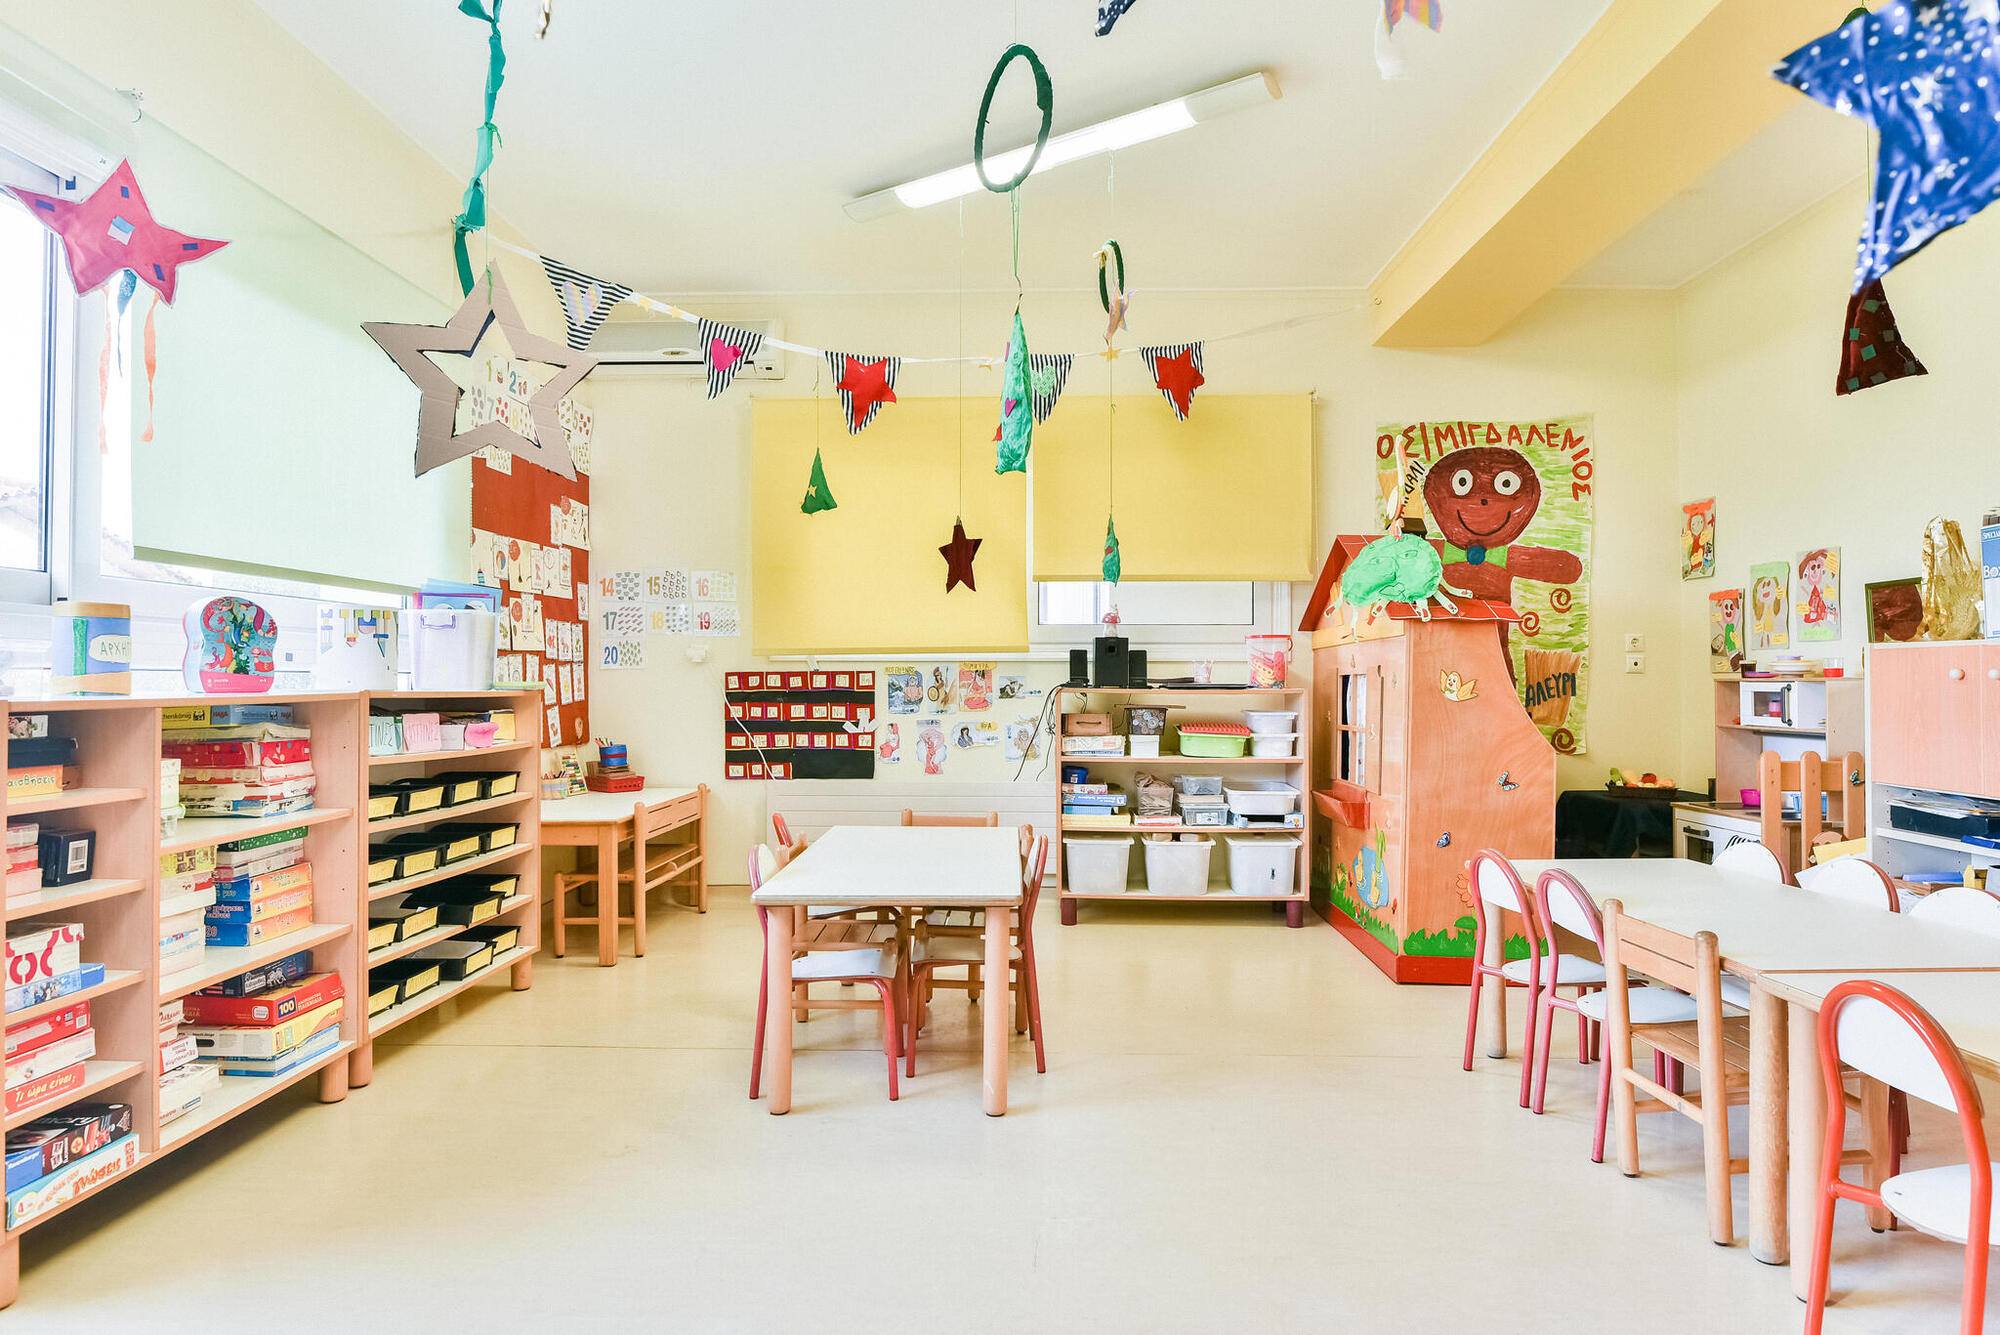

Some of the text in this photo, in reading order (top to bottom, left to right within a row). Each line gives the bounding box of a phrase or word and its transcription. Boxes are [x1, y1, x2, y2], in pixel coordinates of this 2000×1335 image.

[509, 371, 517, 394] 2
[600, 577, 614, 597] 14
[646, 576, 660, 596] 15
[696, 577, 709, 597] 16
[603, 611, 617, 630] 17
[650, 611, 664, 630] 18
[698, 611, 710, 630] 19
[604, 646, 618, 664] 20
[1525, 672, 1576, 708] ΑΛΕΥΡΙ
[278, 1000, 296, 1016] 100
